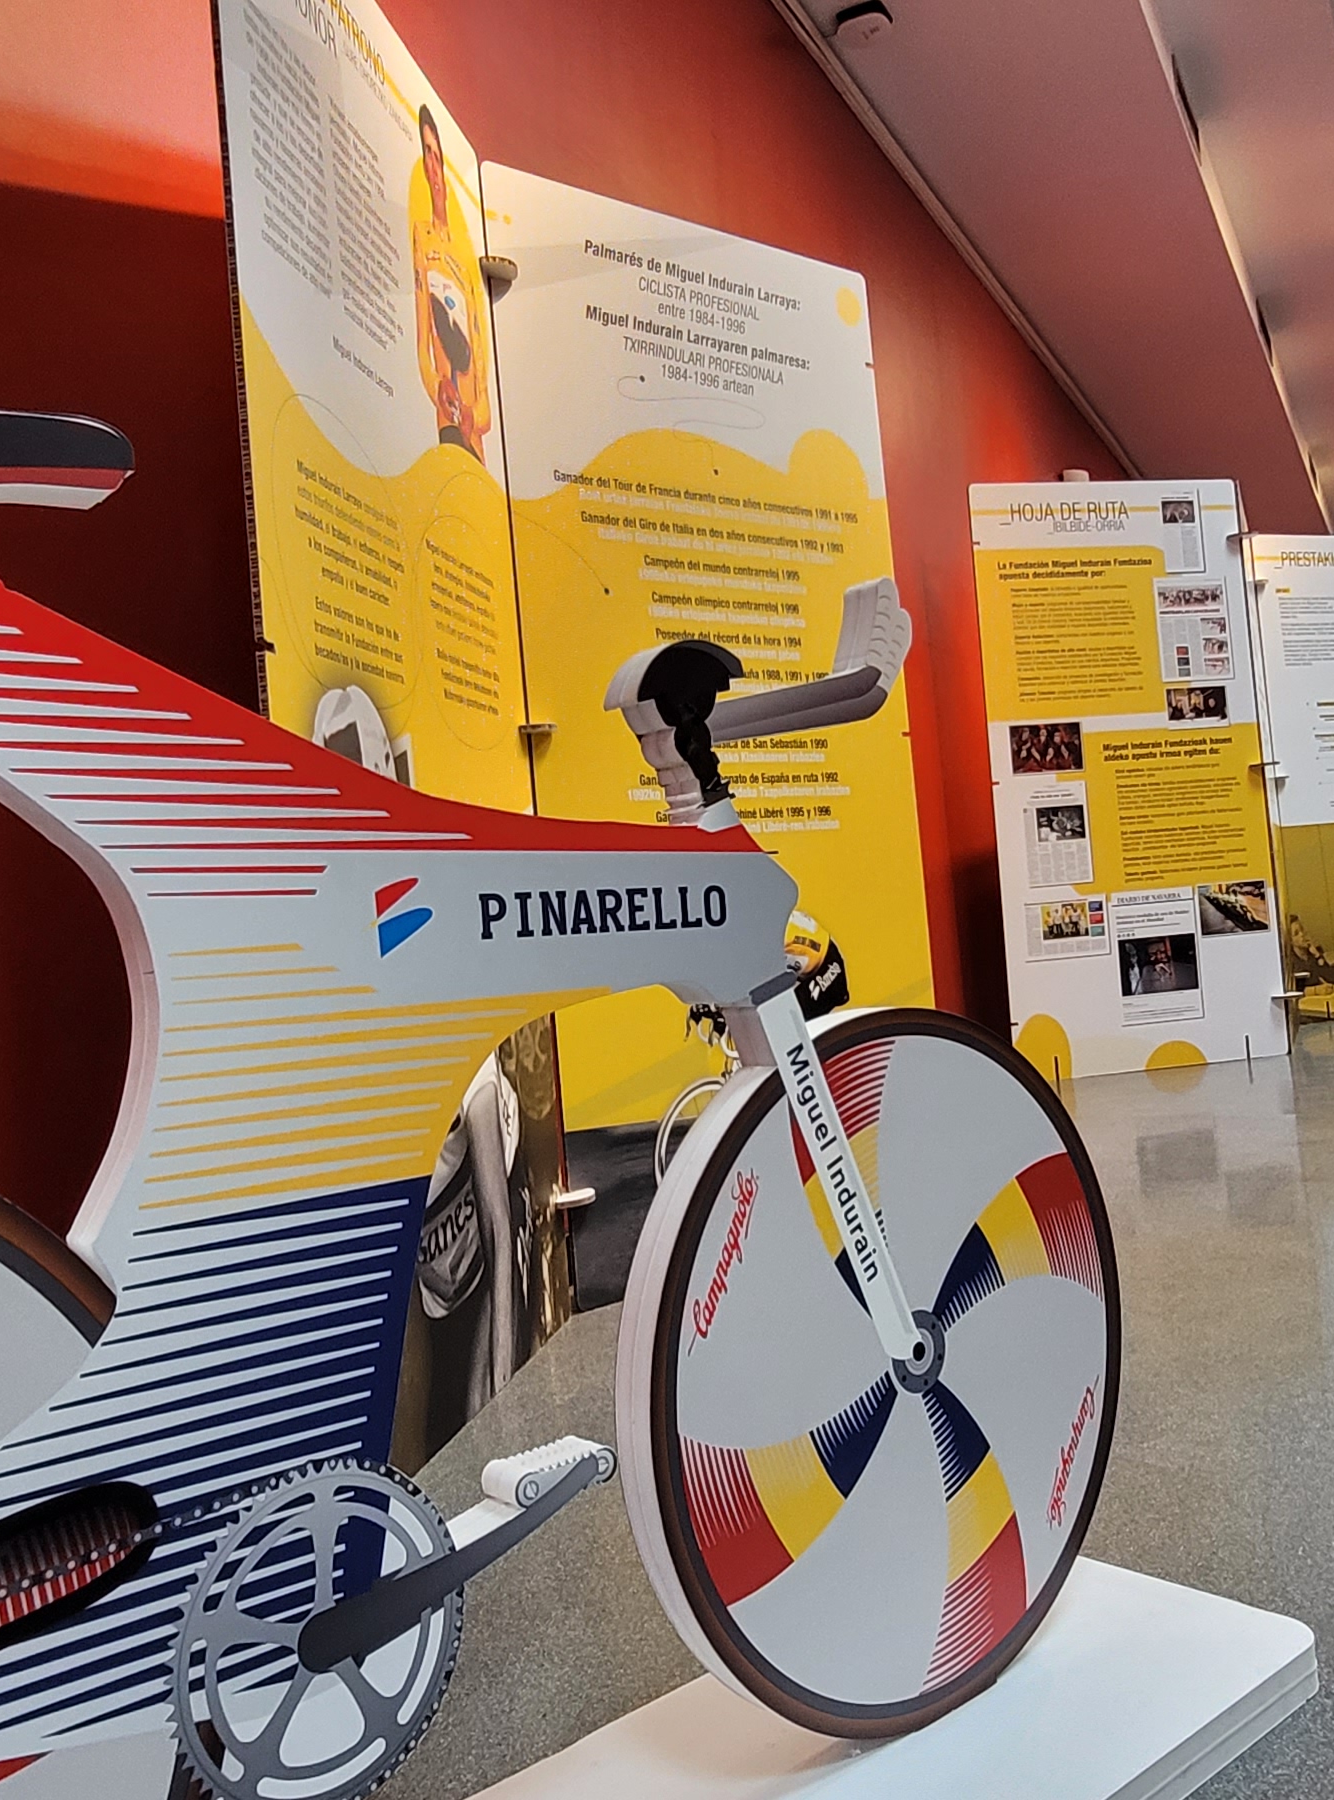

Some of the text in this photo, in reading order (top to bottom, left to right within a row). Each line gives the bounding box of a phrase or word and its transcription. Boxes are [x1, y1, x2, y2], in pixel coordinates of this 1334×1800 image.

[295, 0, 337, 58] ONOR
[584, 239, 801, 311] Palmarés de Miguel Indurain Larraya:
[639, 276, 759, 321] CICLISTA PROFESIONAL
[658, 302, 746, 334] entre 1984-1996
[586, 305, 810, 370] Miguel Indurain Larrayaren palmaresa:
[623, 336, 783, 385] TXIRRINDULARI PROFESIONALA
[662, 364, 754, 396] 1984-1996 artean
[554, 469, 594, 486] Ganador
[596, 476, 610, 488] del
[613, 479, 633, 491] Tour
[636, 483, 646, 494] de
[649, 483, 681, 498] Francia
[684, 488, 716, 504] durante
[719, 495, 740, 507] cinco
[743, 498, 761, 510] años
[764, 502, 813, 517] consecutivos
[815, 508, 831, 520] 1991
[841, 512, 858, 523] 1995
[1060, 502, 1082, 520] DE
[1088, 501, 1129, 520] RUTA
[581, 511, 620, 526] Ganador
[623, 517, 636, 528] del
[639, 518, 657, 531] Giro
[660, 521, 670, 532] de
[673, 523, 694, 535] Italia
[697, 526, 706, 536] en
[709, 528, 724, 539] dos
[727, 530, 746, 542] años
[748, 534, 798, 549] consecutivos
[801, 539, 818, 550] 1992
[820, 543, 824, 553] y
[644, 554, 685, 570] Campeón
[688, 560, 700, 572] del
[703, 563, 731, 574] mundo
[733, 566, 779, 581] contrarreloj
[782, 570, 799, 581] 1995
[997, 558, 1152, 571] La Fundación Miguel Indurain Fundazioa
[999, 569, 1106, 581] apuesta decididamente por:
[651, 591, 692, 608] Campeón
[733, 598, 779, 615] contrarreloj
[656, 628, 801, 648] Poseedor del récord de la hora 1994
[785, 671, 802, 681] 1991
[805, 673, 810, 683] y
[753, 738, 767, 749] San
[770, 737, 808, 749] Sebastián
[810, 738, 828, 748] 1990
[1103, 737, 1232, 753] Miguel Indurain Fundazioak hauen
[1104, 753, 1129, 762] aldeko
[1132, 751, 1157, 761] apustu
[1160, 750, 1181, 758] irmoa
[1184, 748, 1207, 758] egiten
[748, 772, 839, 786] de España en ruta 1992
[759, 806, 831, 820] Libéré 1995 y 1996
[478, 884, 727, 940] PINARELLO
[785, 1042, 879, 1284] Miguel Indurain
[687, 1167, 759, 1357] Campagnolo
[1046, 1374, 1100, 1530] Campagnolo
